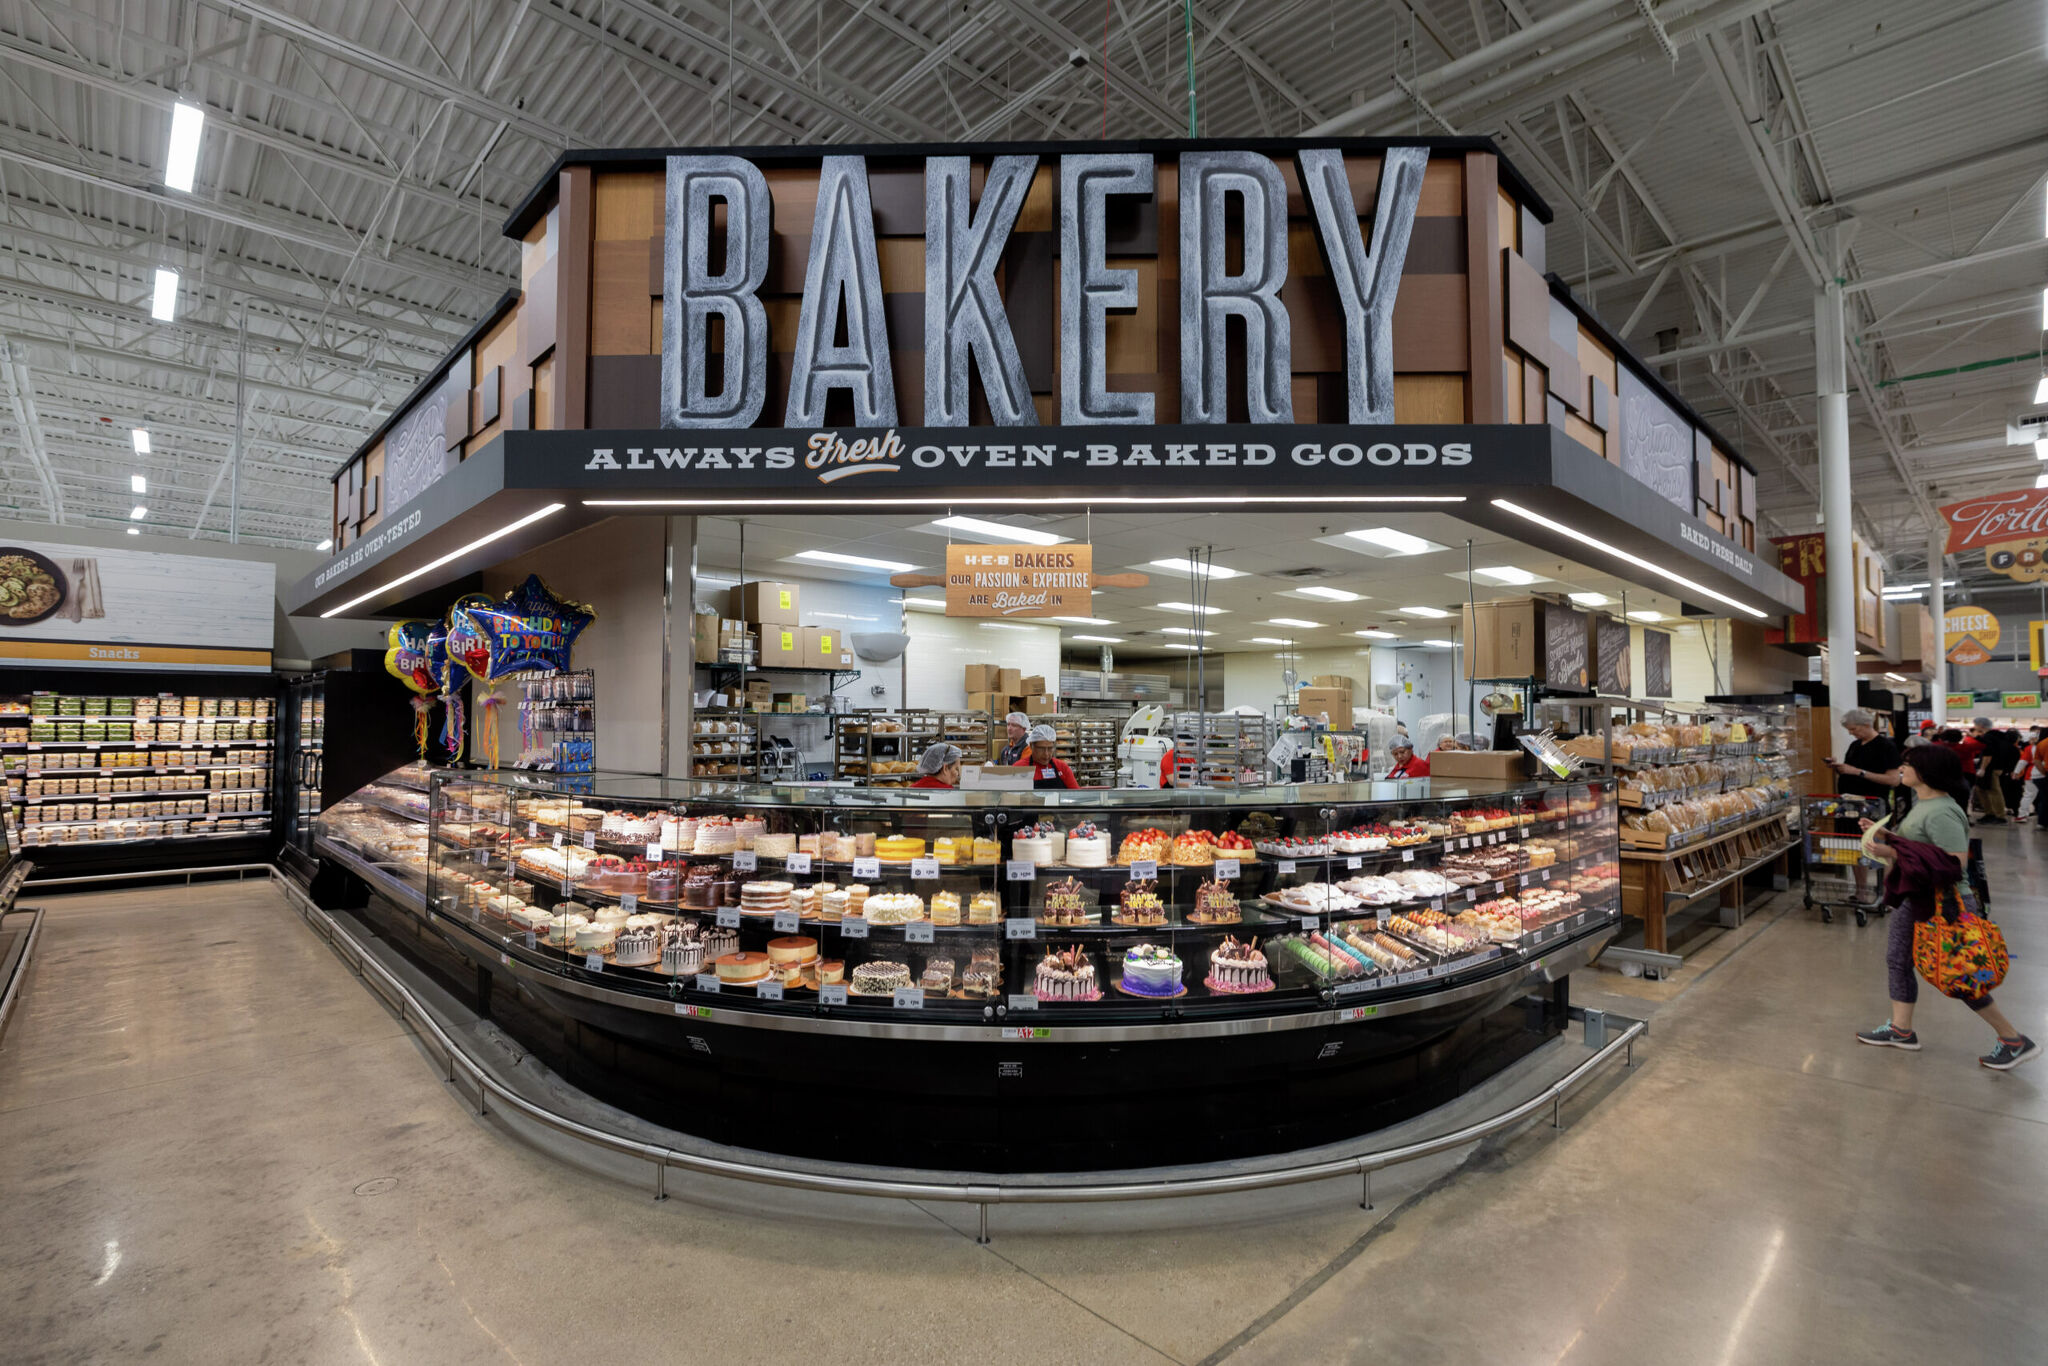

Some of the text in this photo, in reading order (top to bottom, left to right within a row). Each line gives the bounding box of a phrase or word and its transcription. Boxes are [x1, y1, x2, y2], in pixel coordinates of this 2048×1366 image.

[660, 146, 1431, 429] BAKERY
[584, 446, 796, 471] ALWAYS
[805, 429, 906, 472] Fresh
[1291, 442, 1473, 467] GOODS
[1680, 521, 1754, 577] BAKED FRESH DAILY
[326, 556, 349, 582] BAKERS
[350, 547, 364, 567] ARE
[1014, 553, 1075, 569] BAKERS
[950, 572, 1089, 588] OUR PASSION & EXPERTISE
[968, 590, 1063, 609] ARE Baked IN
[493, 616, 572, 635] BIRTHDAY
[1943, 614, 1991, 633] CHEESE
[500, 633, 565, 649] TO YOU!!!
[89, 647, 140, 660] Snacks
